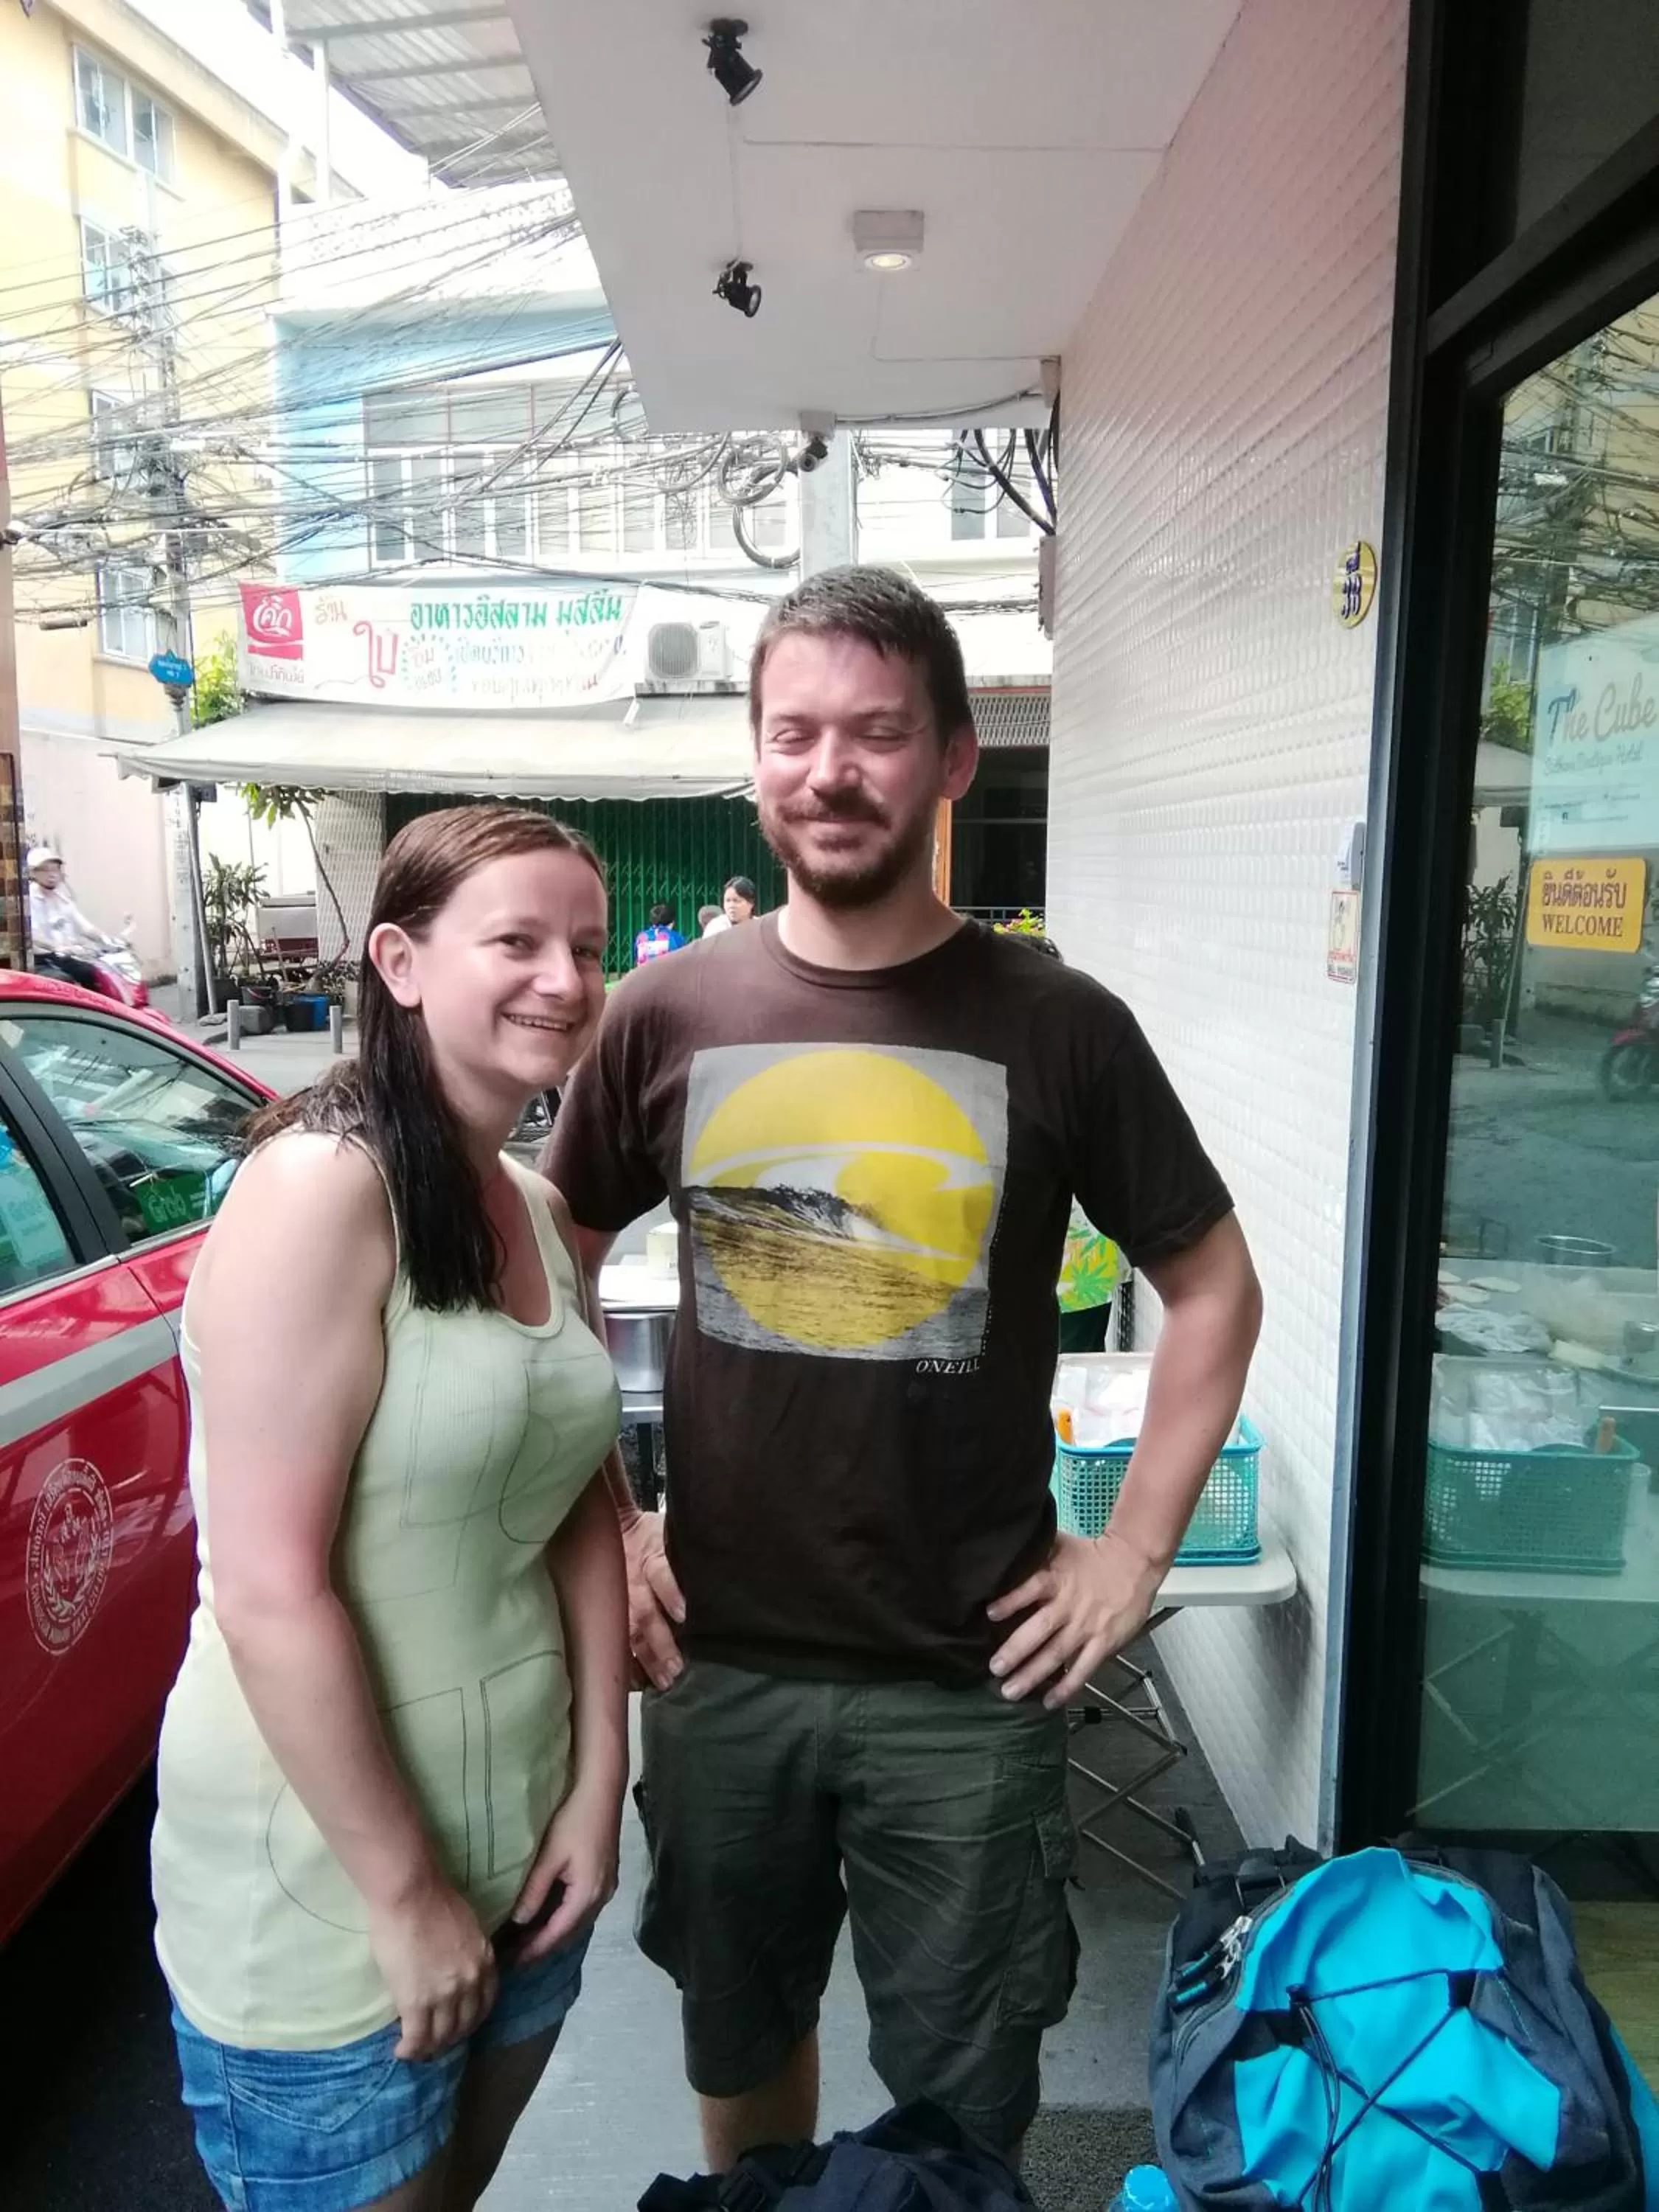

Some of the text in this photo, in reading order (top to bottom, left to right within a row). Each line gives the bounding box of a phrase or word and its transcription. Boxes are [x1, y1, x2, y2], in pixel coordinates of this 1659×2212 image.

[1548, 672, 1658, 747] The Cube
[1542, 914, 1624, 937] WELCOME
